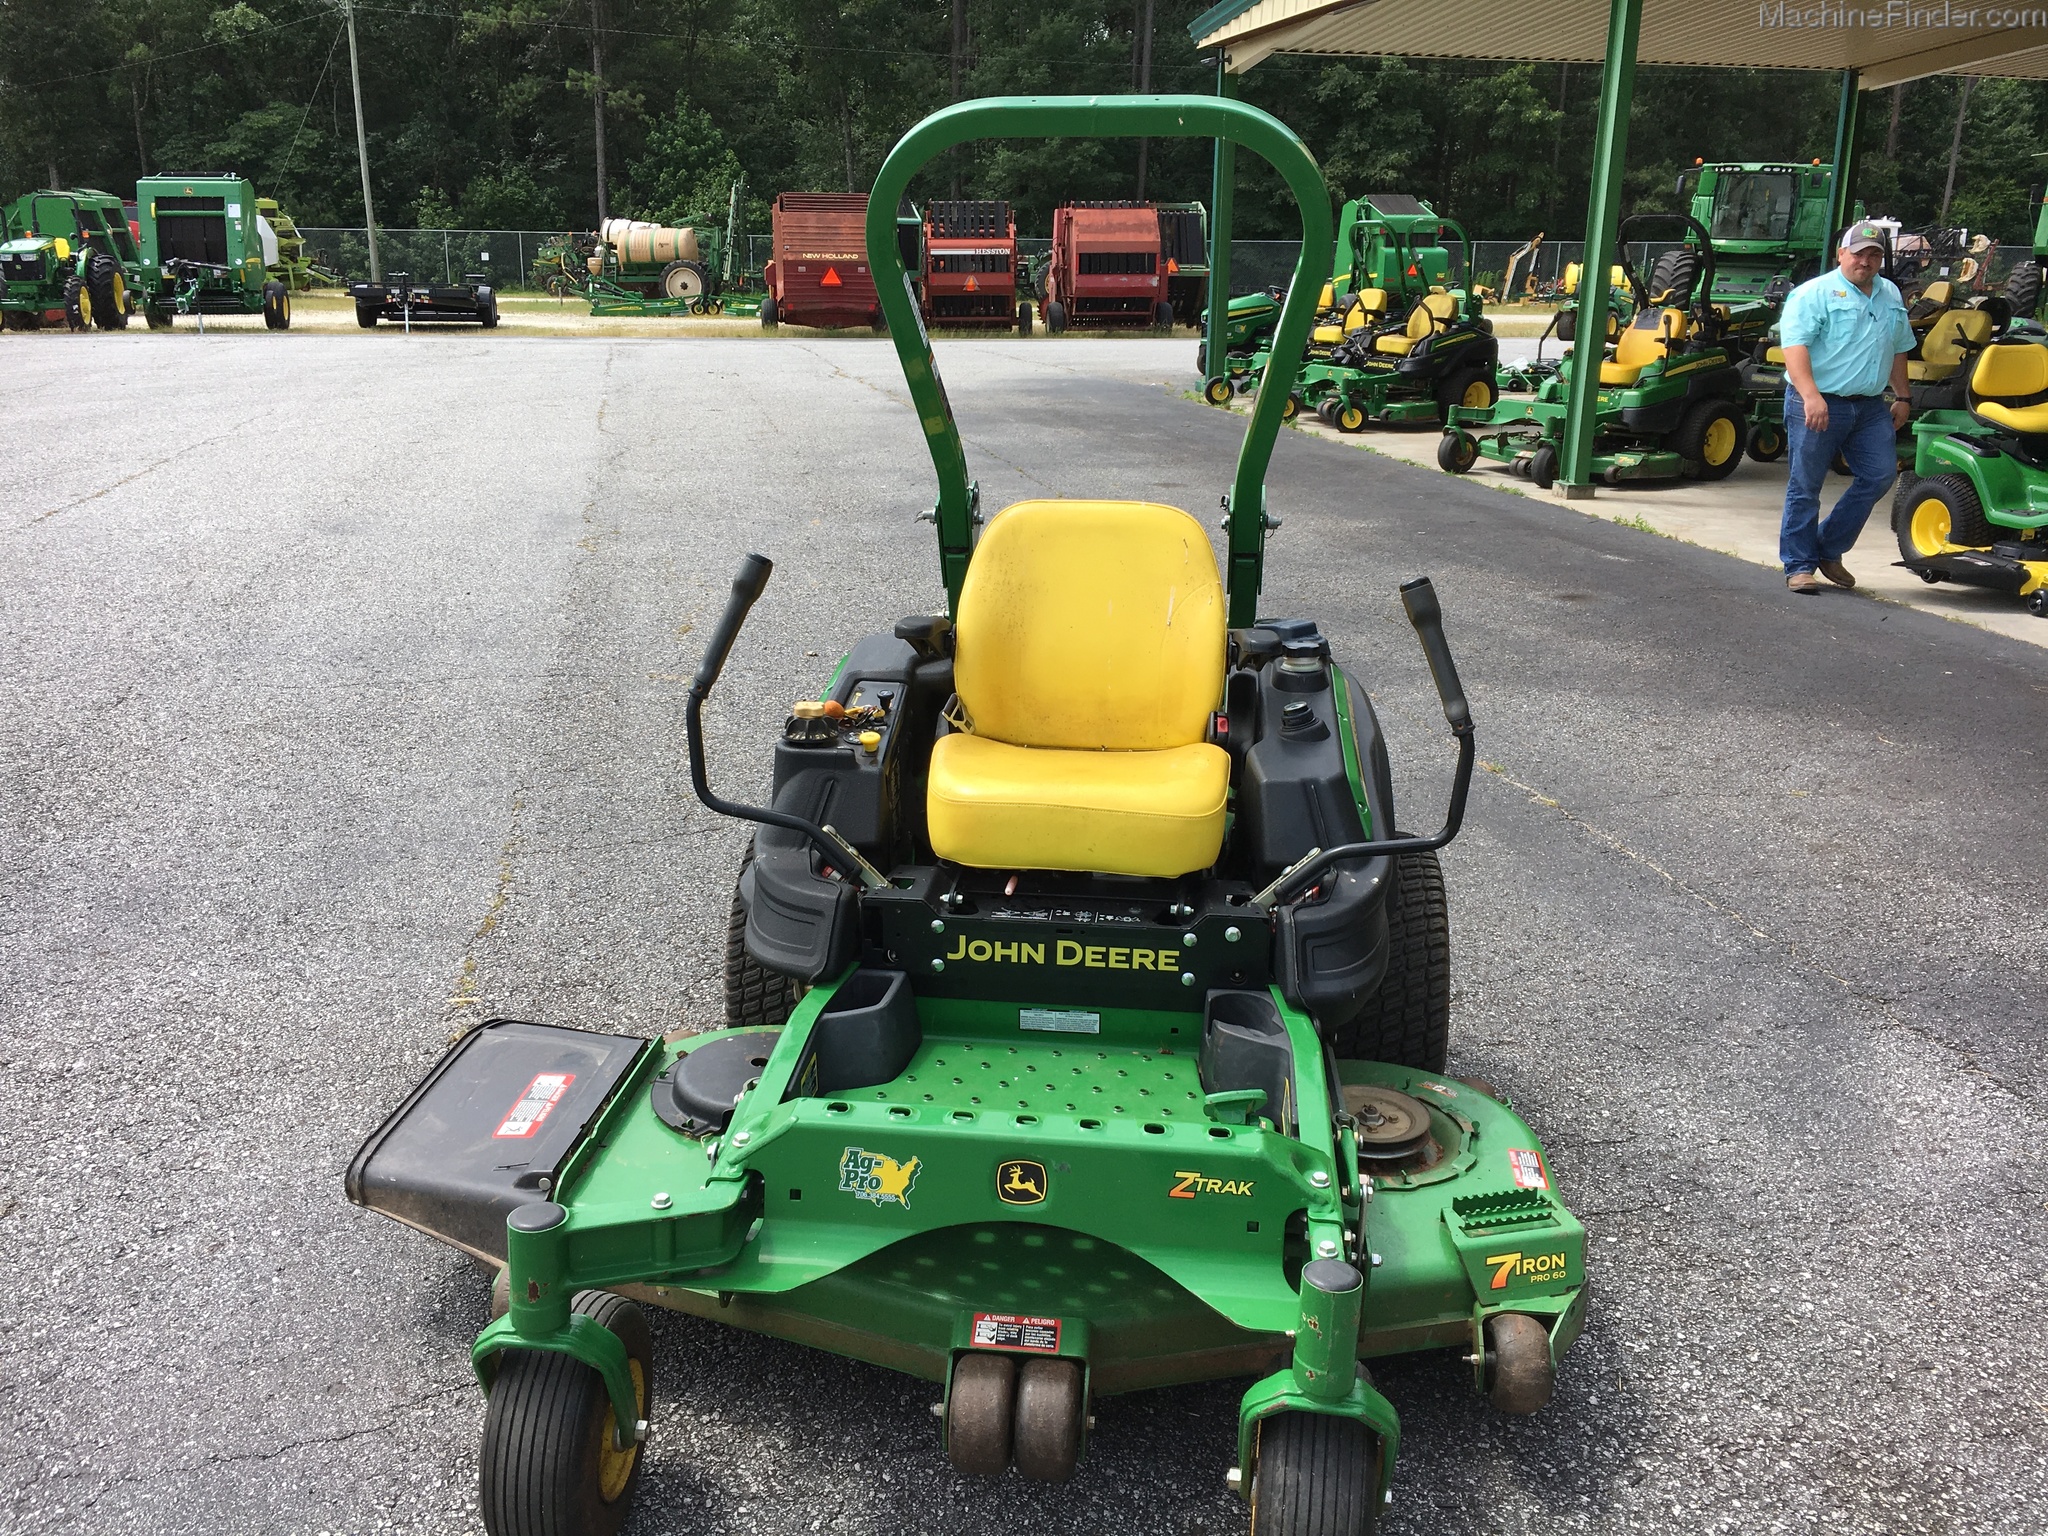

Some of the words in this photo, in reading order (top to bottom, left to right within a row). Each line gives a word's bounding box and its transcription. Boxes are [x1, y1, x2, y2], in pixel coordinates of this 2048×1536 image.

[946, 934, 1045, 965] JOHN
[1056, 939, 1180, 972] DEERE
[842, 1148, 884, 1175] Ag-
[841, 1168, 882, 1190] Pro
[1530, 1273, 1551, 1284] PRO
[1552, 1270, 1567, 1280] 60
[991, 1314, 1016, 1323] DANGER
[1030, 1317, 1056, 1326] PELIGRO
